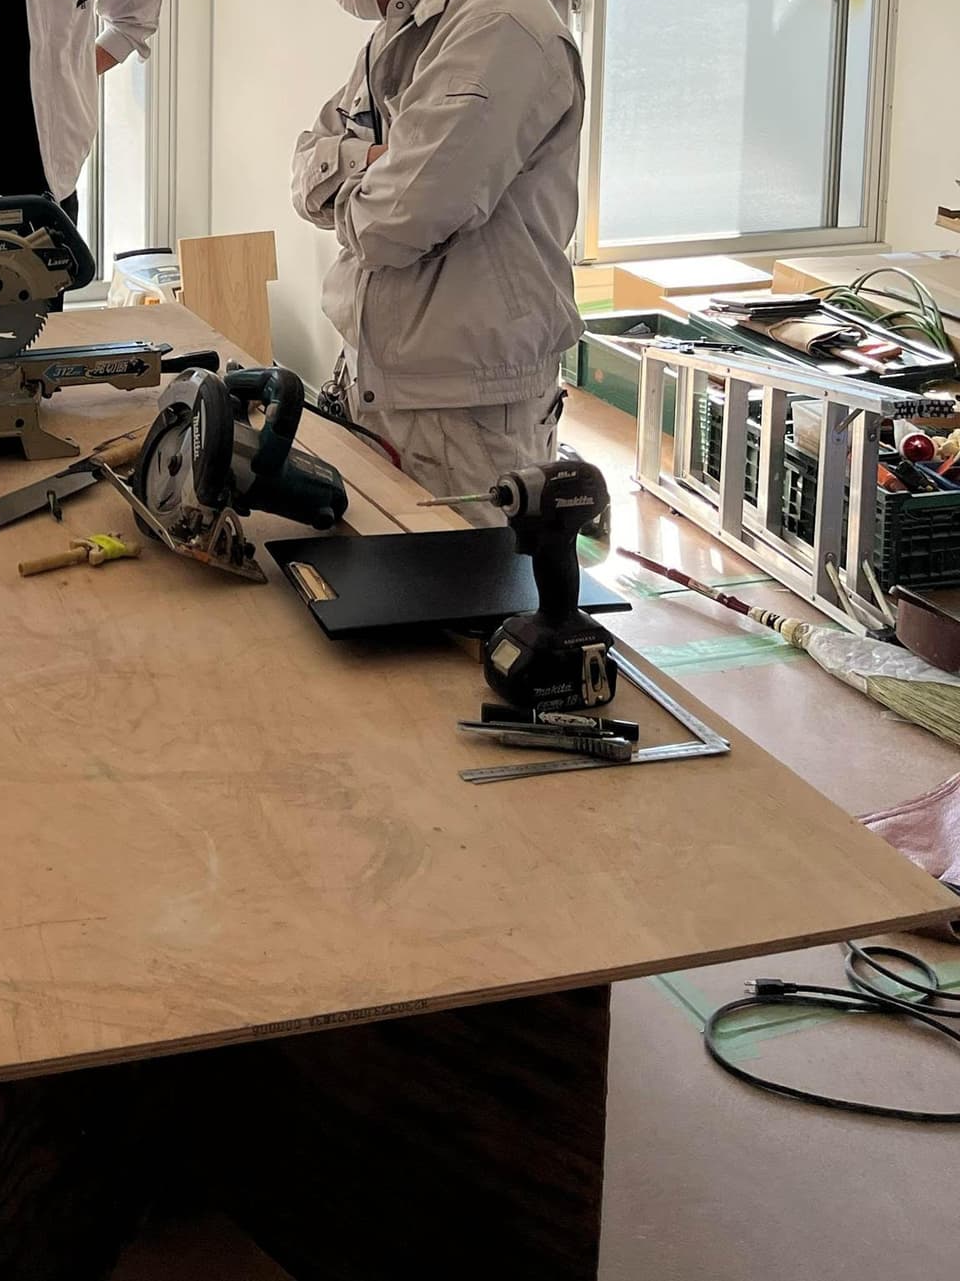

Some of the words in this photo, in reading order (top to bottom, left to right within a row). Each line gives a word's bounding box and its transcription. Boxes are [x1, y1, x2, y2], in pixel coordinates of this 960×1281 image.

[192, 410, 201, 461] makita
[555, 495, 594, 508] makita
[533, 683, 573, 697] makita
